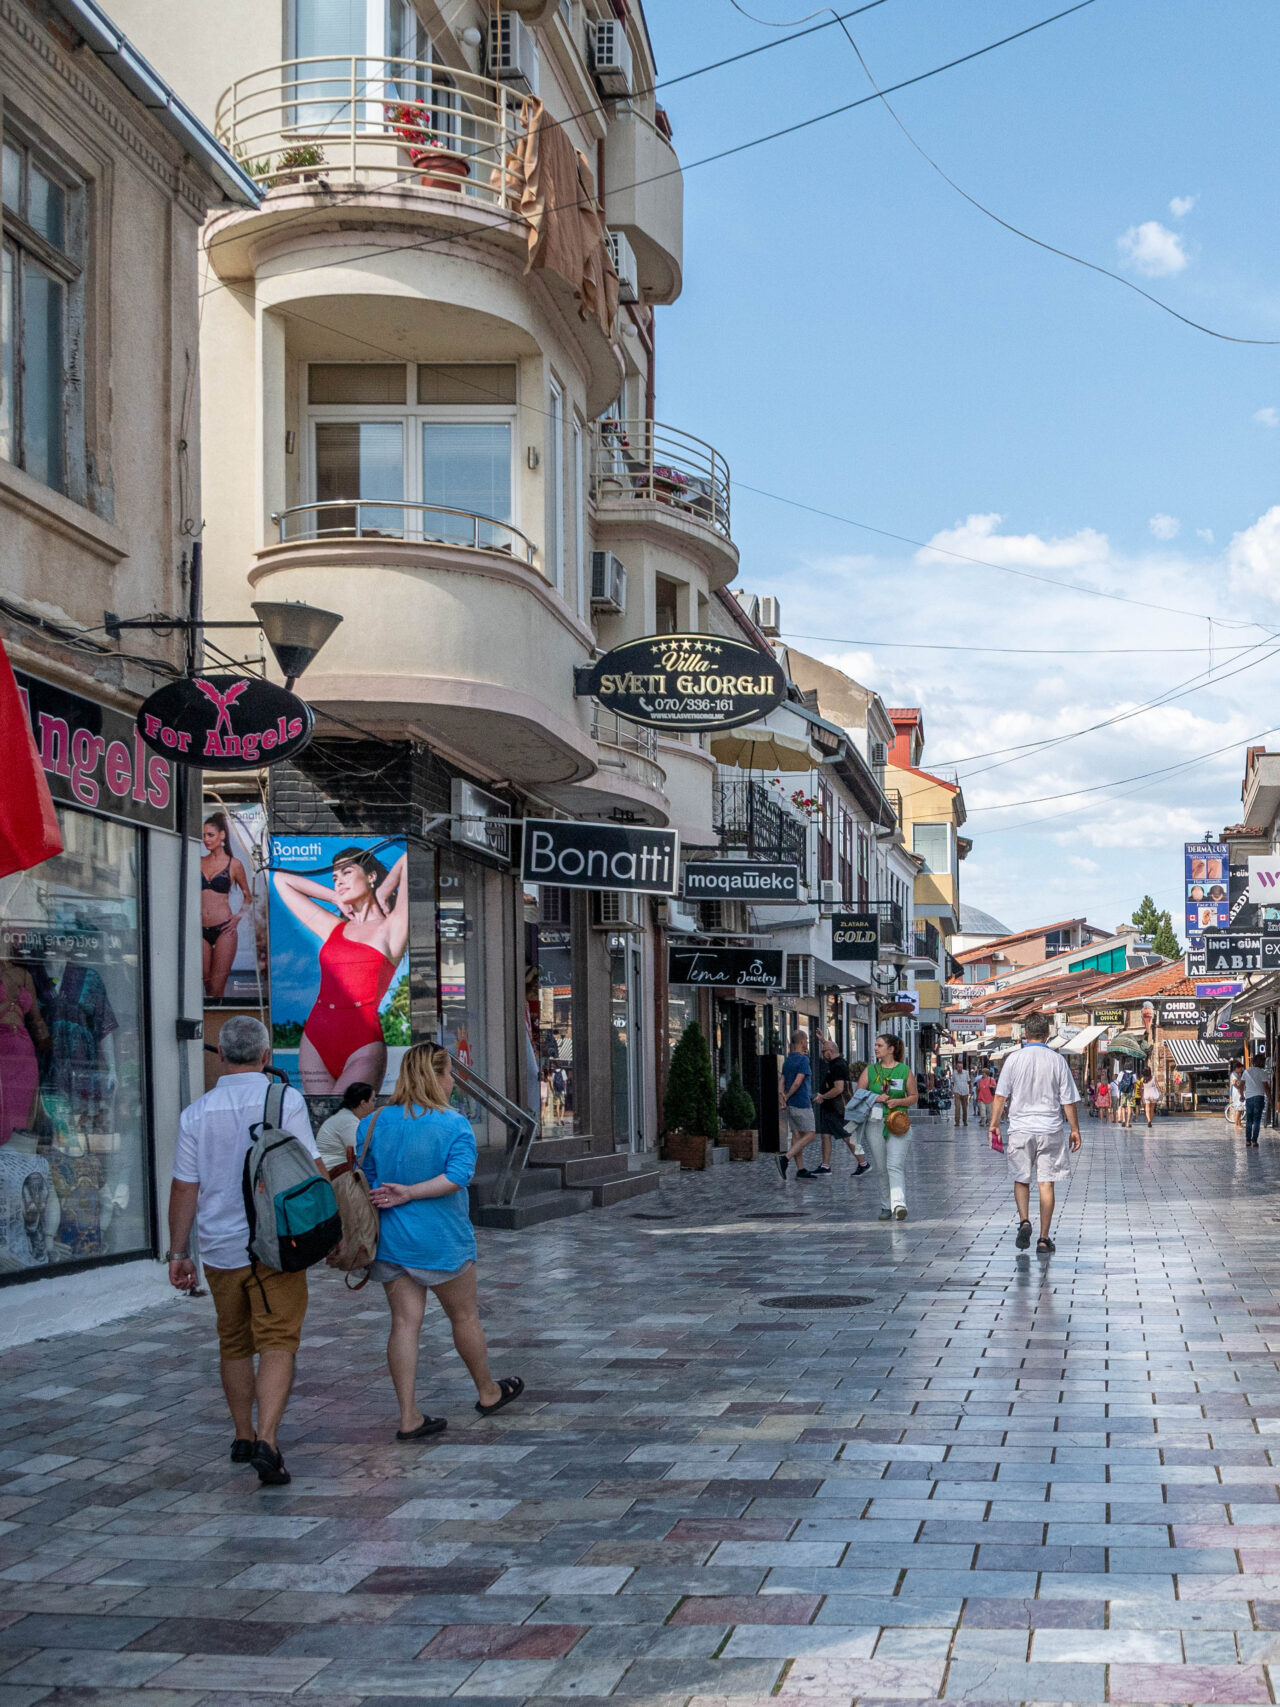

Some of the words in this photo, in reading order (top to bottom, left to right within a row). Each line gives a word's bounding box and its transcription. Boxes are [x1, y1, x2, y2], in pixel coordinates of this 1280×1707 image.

[600, 671, 667, 695] SVETI
[676, 675, 775, 696] GJORGJI
[18, 685, 171, 809] ngels
[144, 713, 192, 752] For
[203, 715, 303, 761] Angels
[273, 841, 322, 856] Bonatti
[531, 830, 670, 883] Bonatti
[833, 930, 877, 944] GOLD
[675, 951, 731, 982] Tema
[737, 970, 777, 986] Jewelry
[1162, 1011, 1199, 1020] TATTOO
[1165, 1002, 1196, 1011] OHRID
